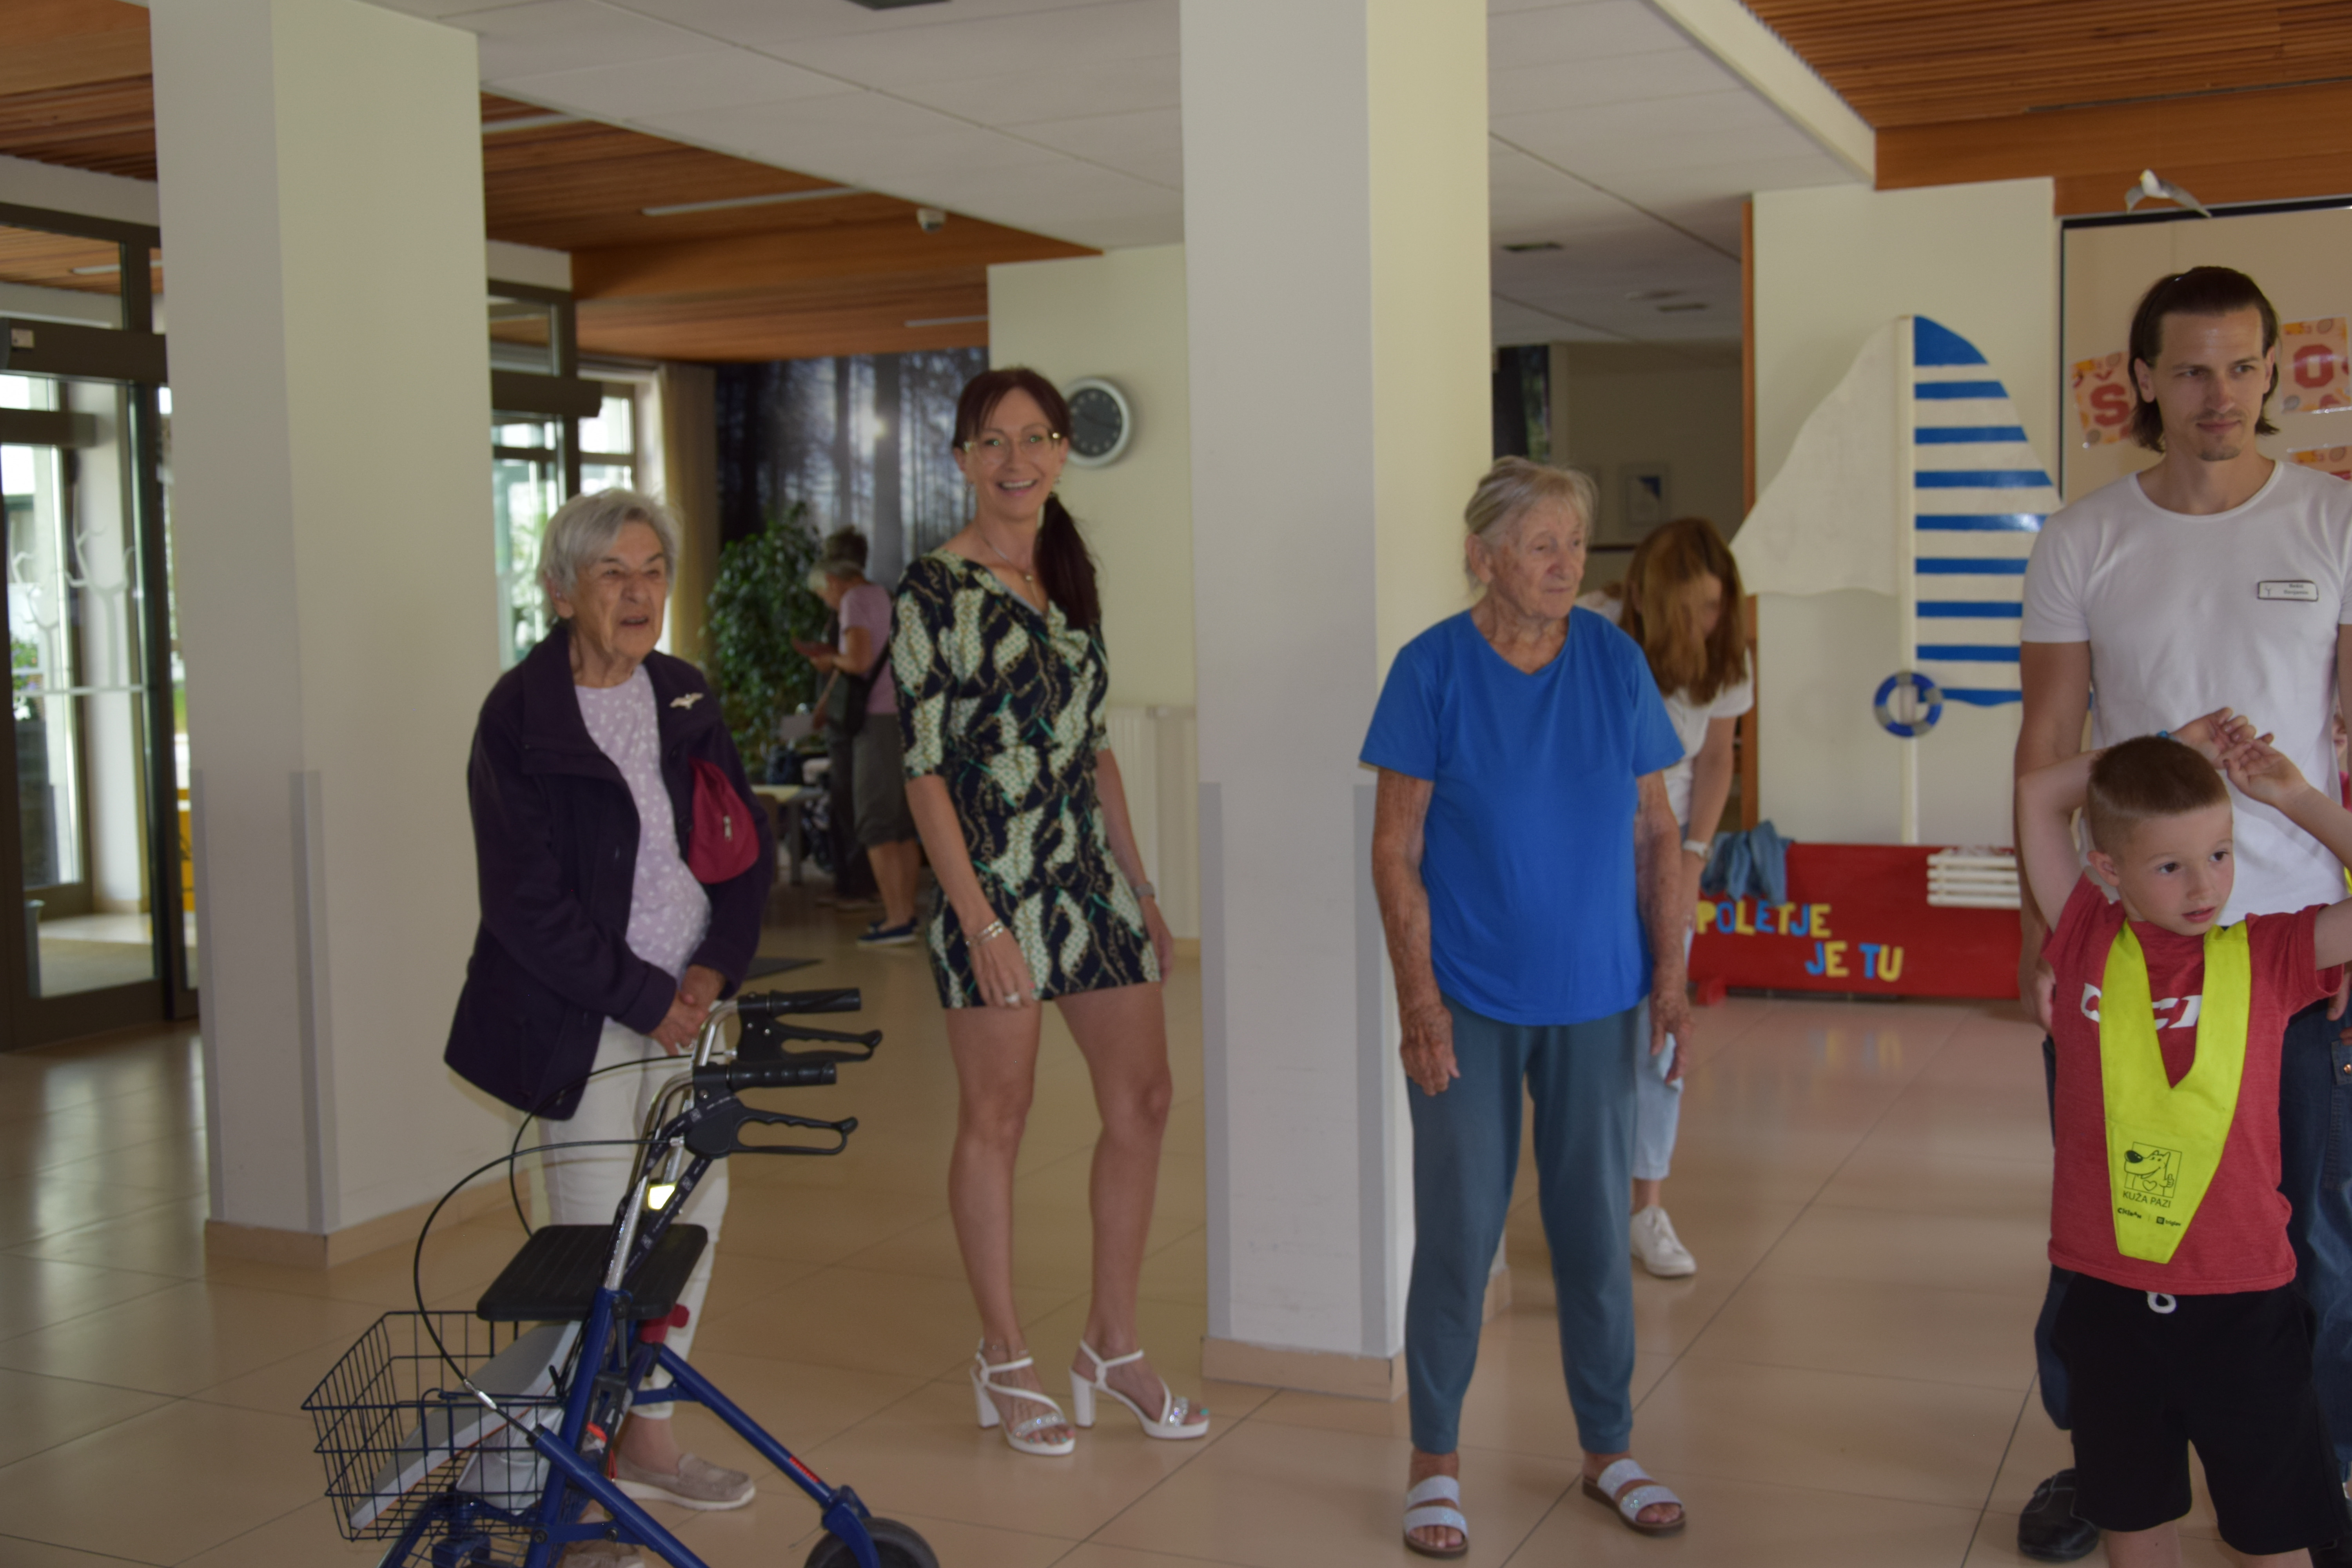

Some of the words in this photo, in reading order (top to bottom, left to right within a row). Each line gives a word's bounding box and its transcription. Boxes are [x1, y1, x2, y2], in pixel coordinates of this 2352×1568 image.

[2090, 383, 2130, 426] S
[1696, 900, 1831, 938] POLETJE
[1805, 941, 1849, 977] JE
[1859, 942, 1904, 982] TU
[2123, 1191, 2147, 1203] KUŽA
[2150, 1197, 2171, 1208] PAZI
